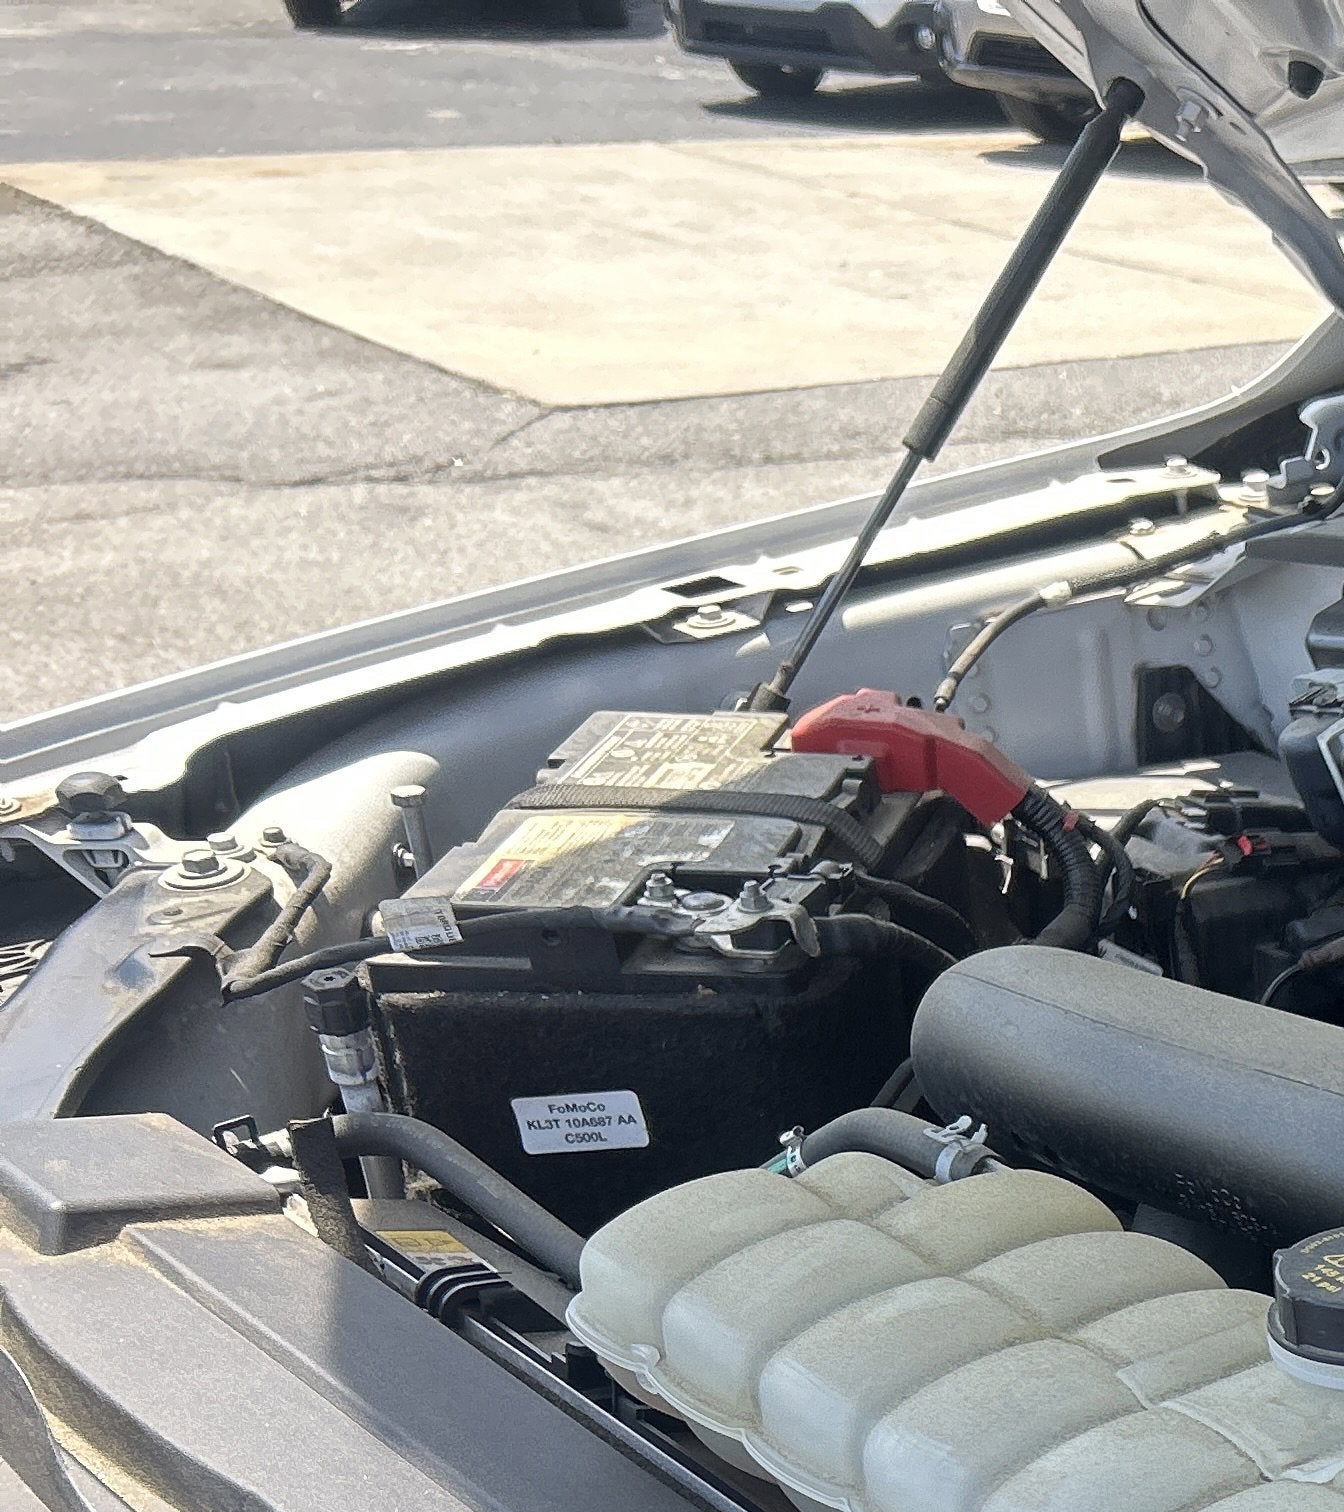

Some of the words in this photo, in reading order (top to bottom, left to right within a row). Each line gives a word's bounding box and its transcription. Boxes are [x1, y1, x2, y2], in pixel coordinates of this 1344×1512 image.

[548, 1101, 606, 1114] FoMoCo
[526, 1119, 561, 1131] KL3T
[617, 1114, 637, 1126] AA
[564, 1132, 607, 1144] C500L
